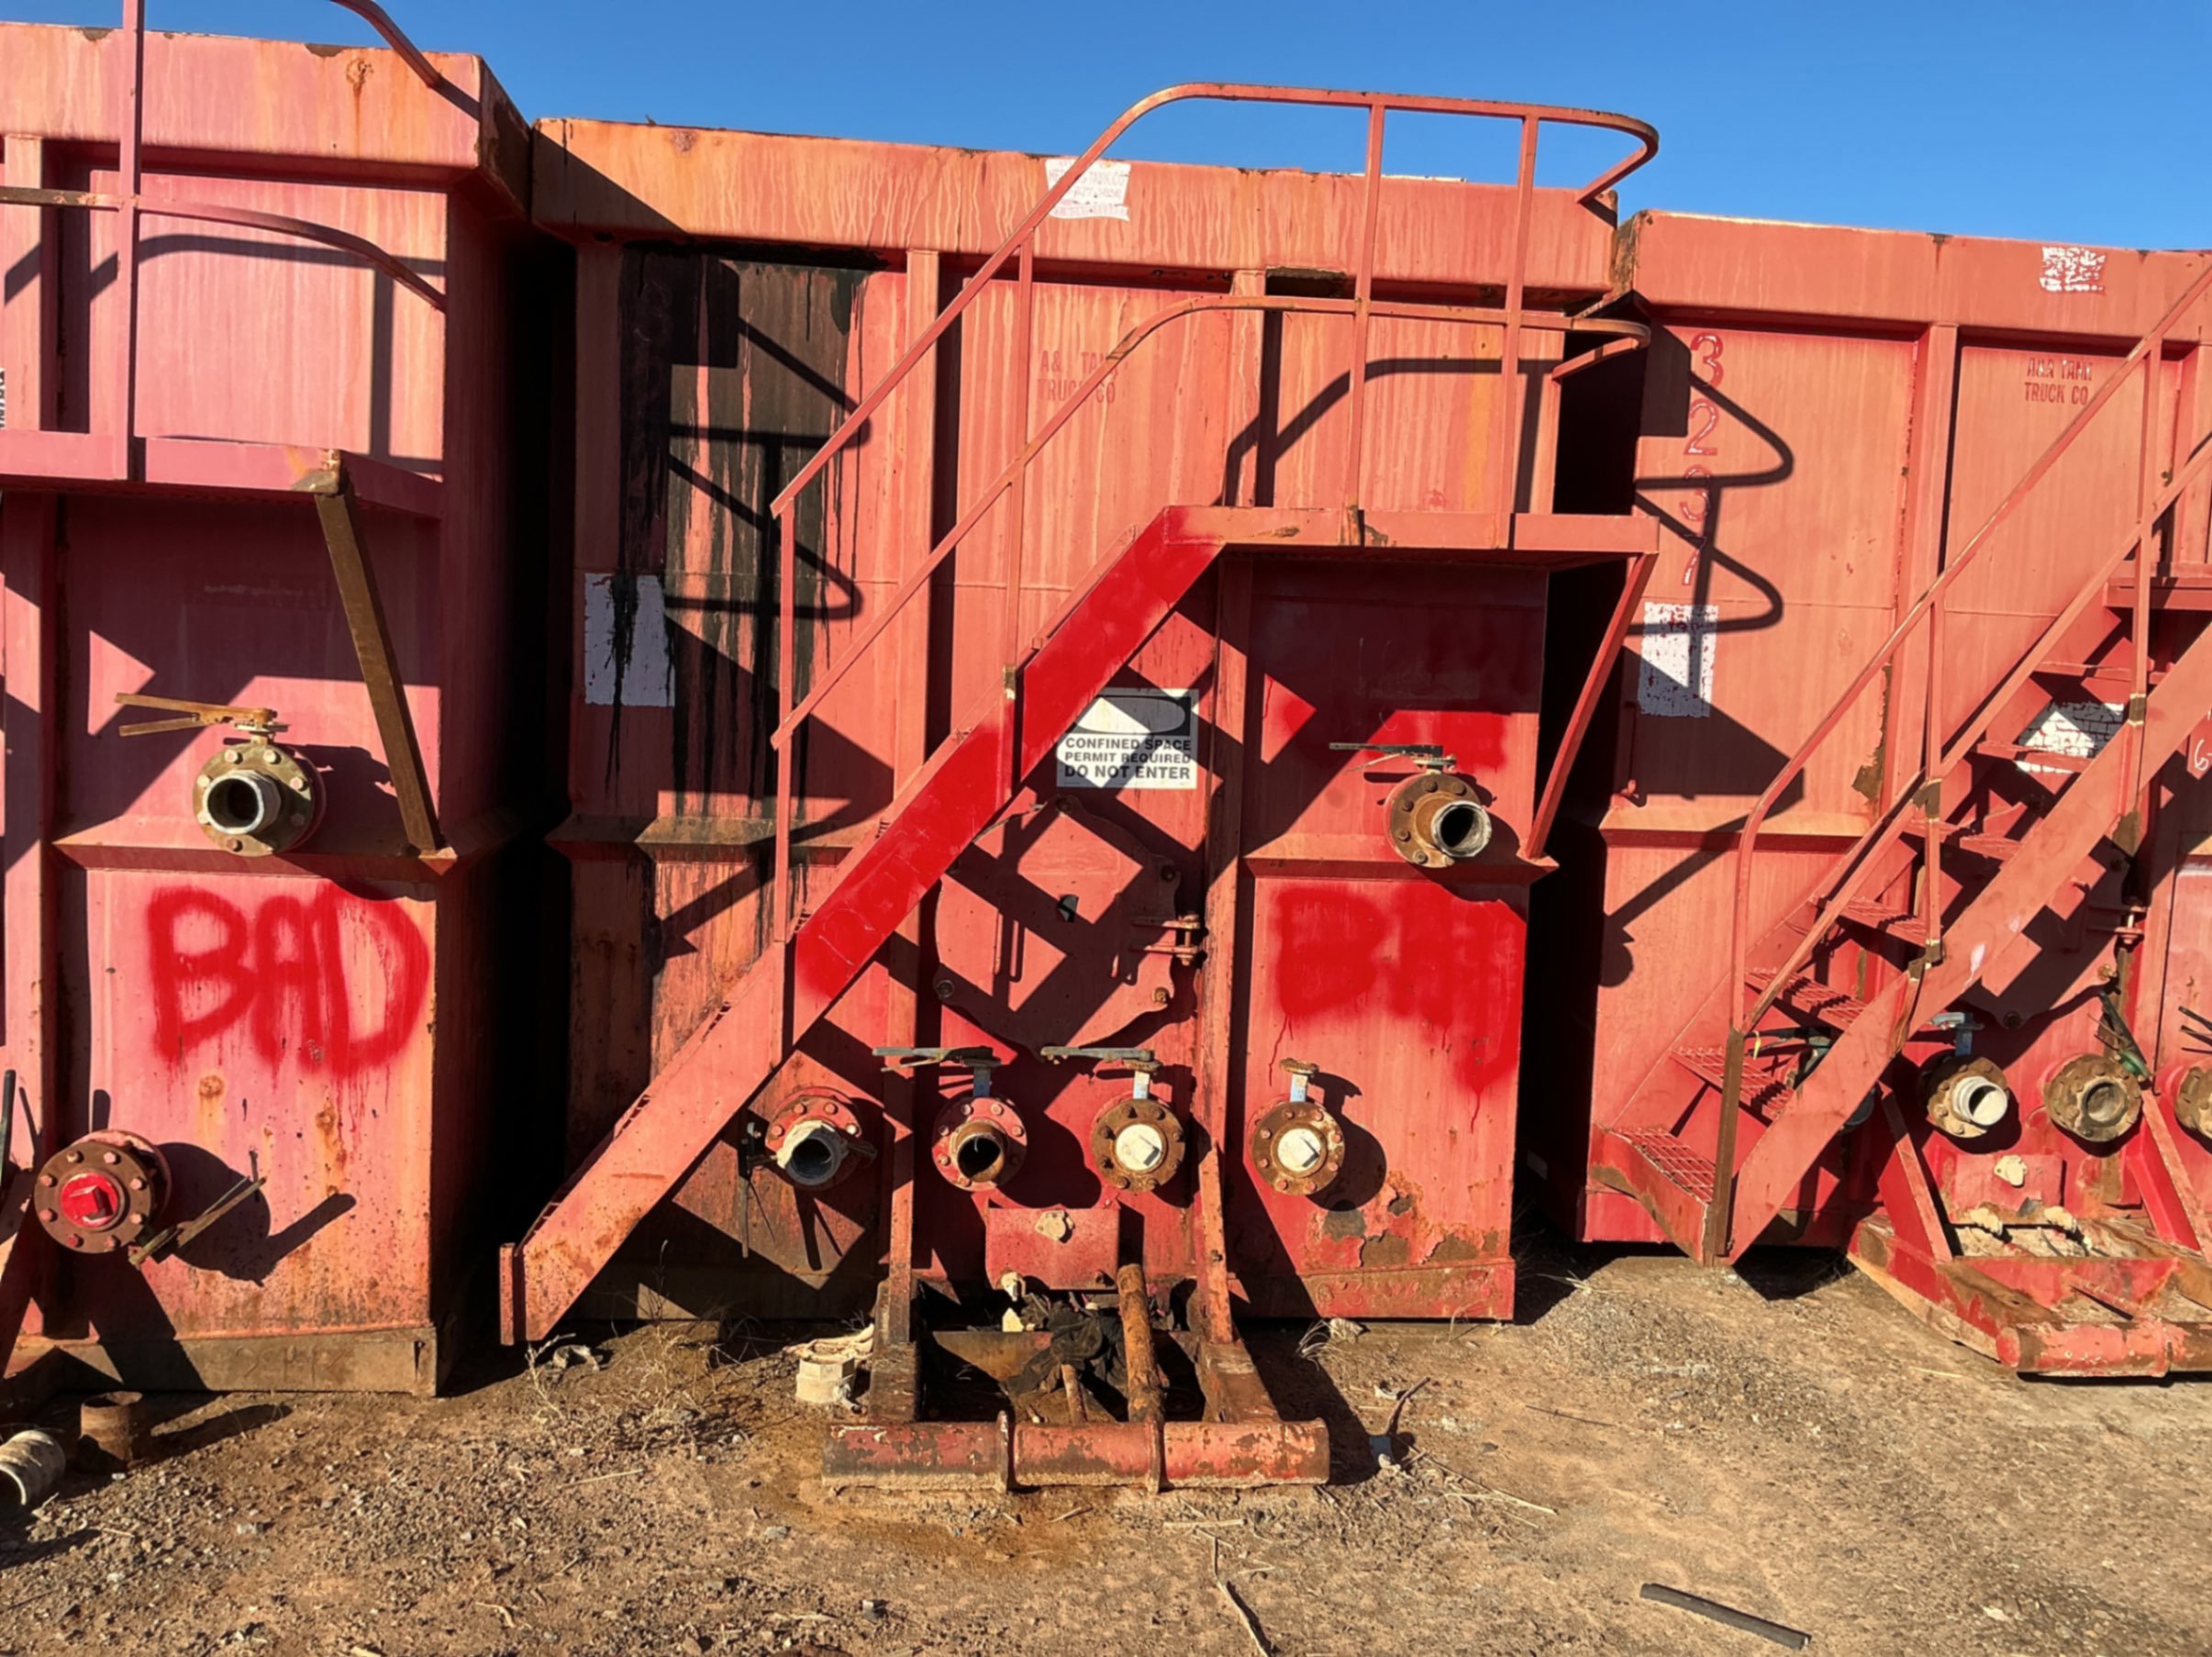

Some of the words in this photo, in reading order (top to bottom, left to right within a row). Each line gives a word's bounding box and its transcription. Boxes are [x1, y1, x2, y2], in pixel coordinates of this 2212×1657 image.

[2024, 382, 2065, 405] TRUCK
[2072, 385, 2089, 406] CO
[1065, 737, 1140, 750] CONFINED
[1144, 739, 1192, 751] SPACE
[1064, 751, 1117, 762] PERMIT
[1120, 752, 1191, 763] REQUIRED
[1064, 764, 1089, 778] DO
[1095, 765, 1130, 779] NOT
[1135, 766, 1191, 780] ENTER
[148, 881, 429, 1079] BAD
